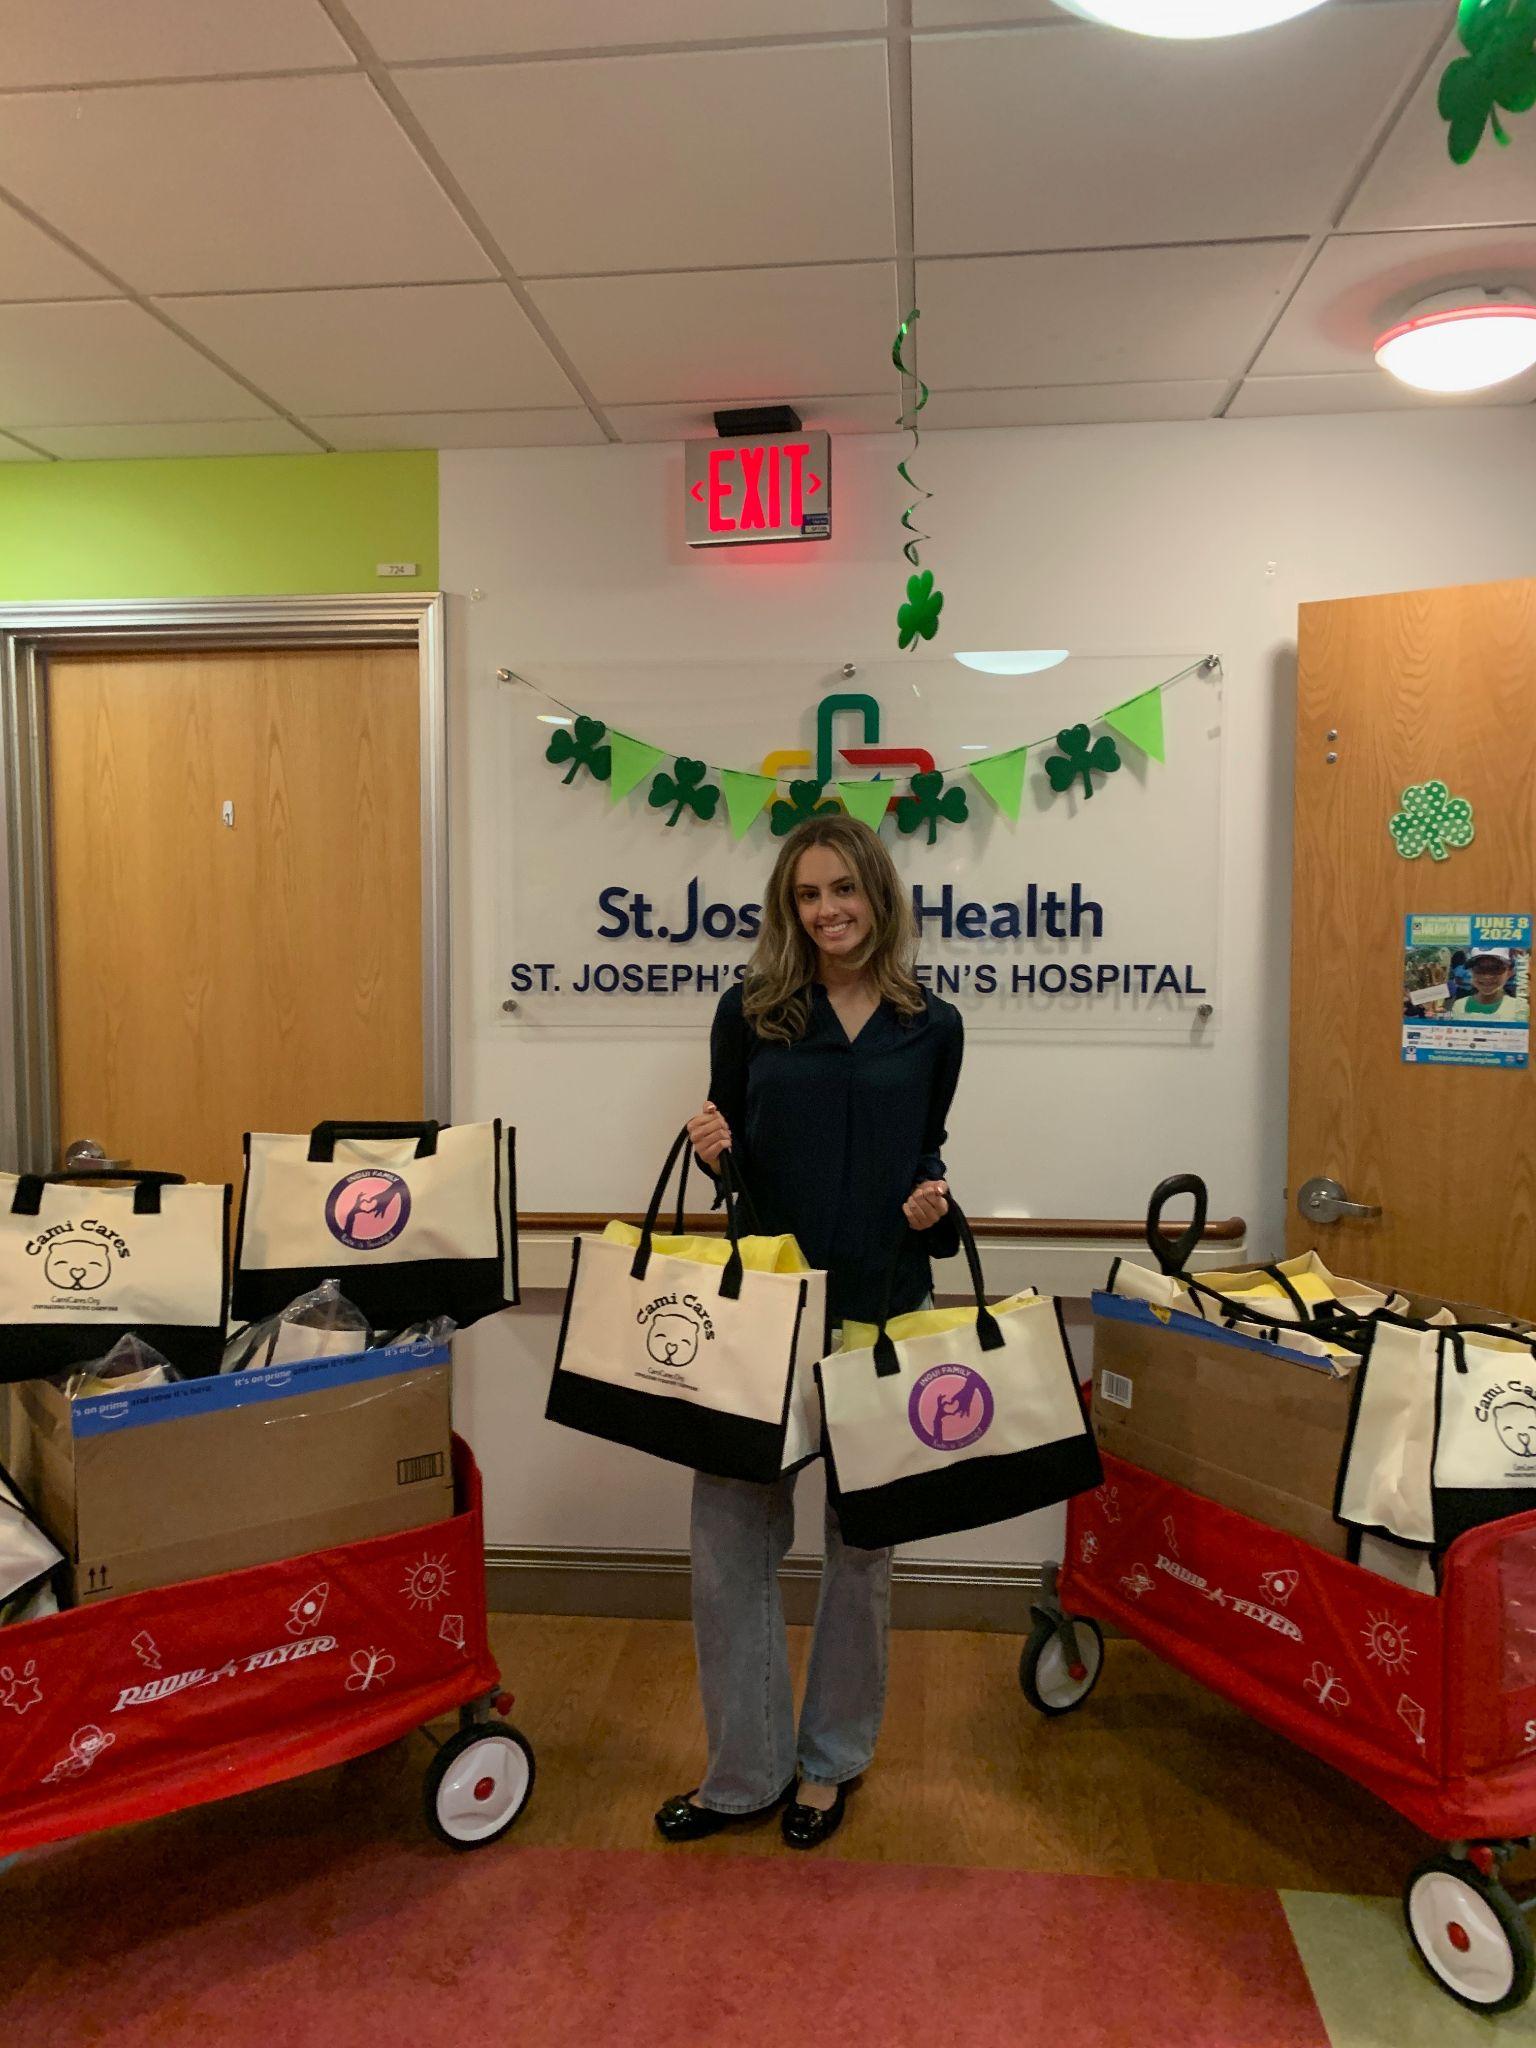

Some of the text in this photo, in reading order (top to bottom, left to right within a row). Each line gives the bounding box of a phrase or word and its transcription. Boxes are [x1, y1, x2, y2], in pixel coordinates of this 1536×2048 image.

[708, 444, 810, 532] EXIT
[912, 883, 1104, 939] Health
[1474, 917, 1515, 929] JUNE
[1517, 917, 1529, 929] 8
[1480, 929, 1523, 940] 2024
[511, 963, 560, 992] ST.
[913, 964, 998, 994] EN'S
[1012, 964, 1207, 994] HOSPITAL
[25, 1219, 130, 1259] Cami Cares
[637, 1293, 715, 1340] Cami Cares
[265, 1370, 291, 1383] prime
[942, 1366, 972, 1377] FAMILY
[99, 1400, 128, 1413] prime
[1474, 1384, 1506, 1423] Cami
[1154, 1554, 1303, 1641] RADIO FLYER
[110, 1636, 337, 1712] RADIO FLYER
